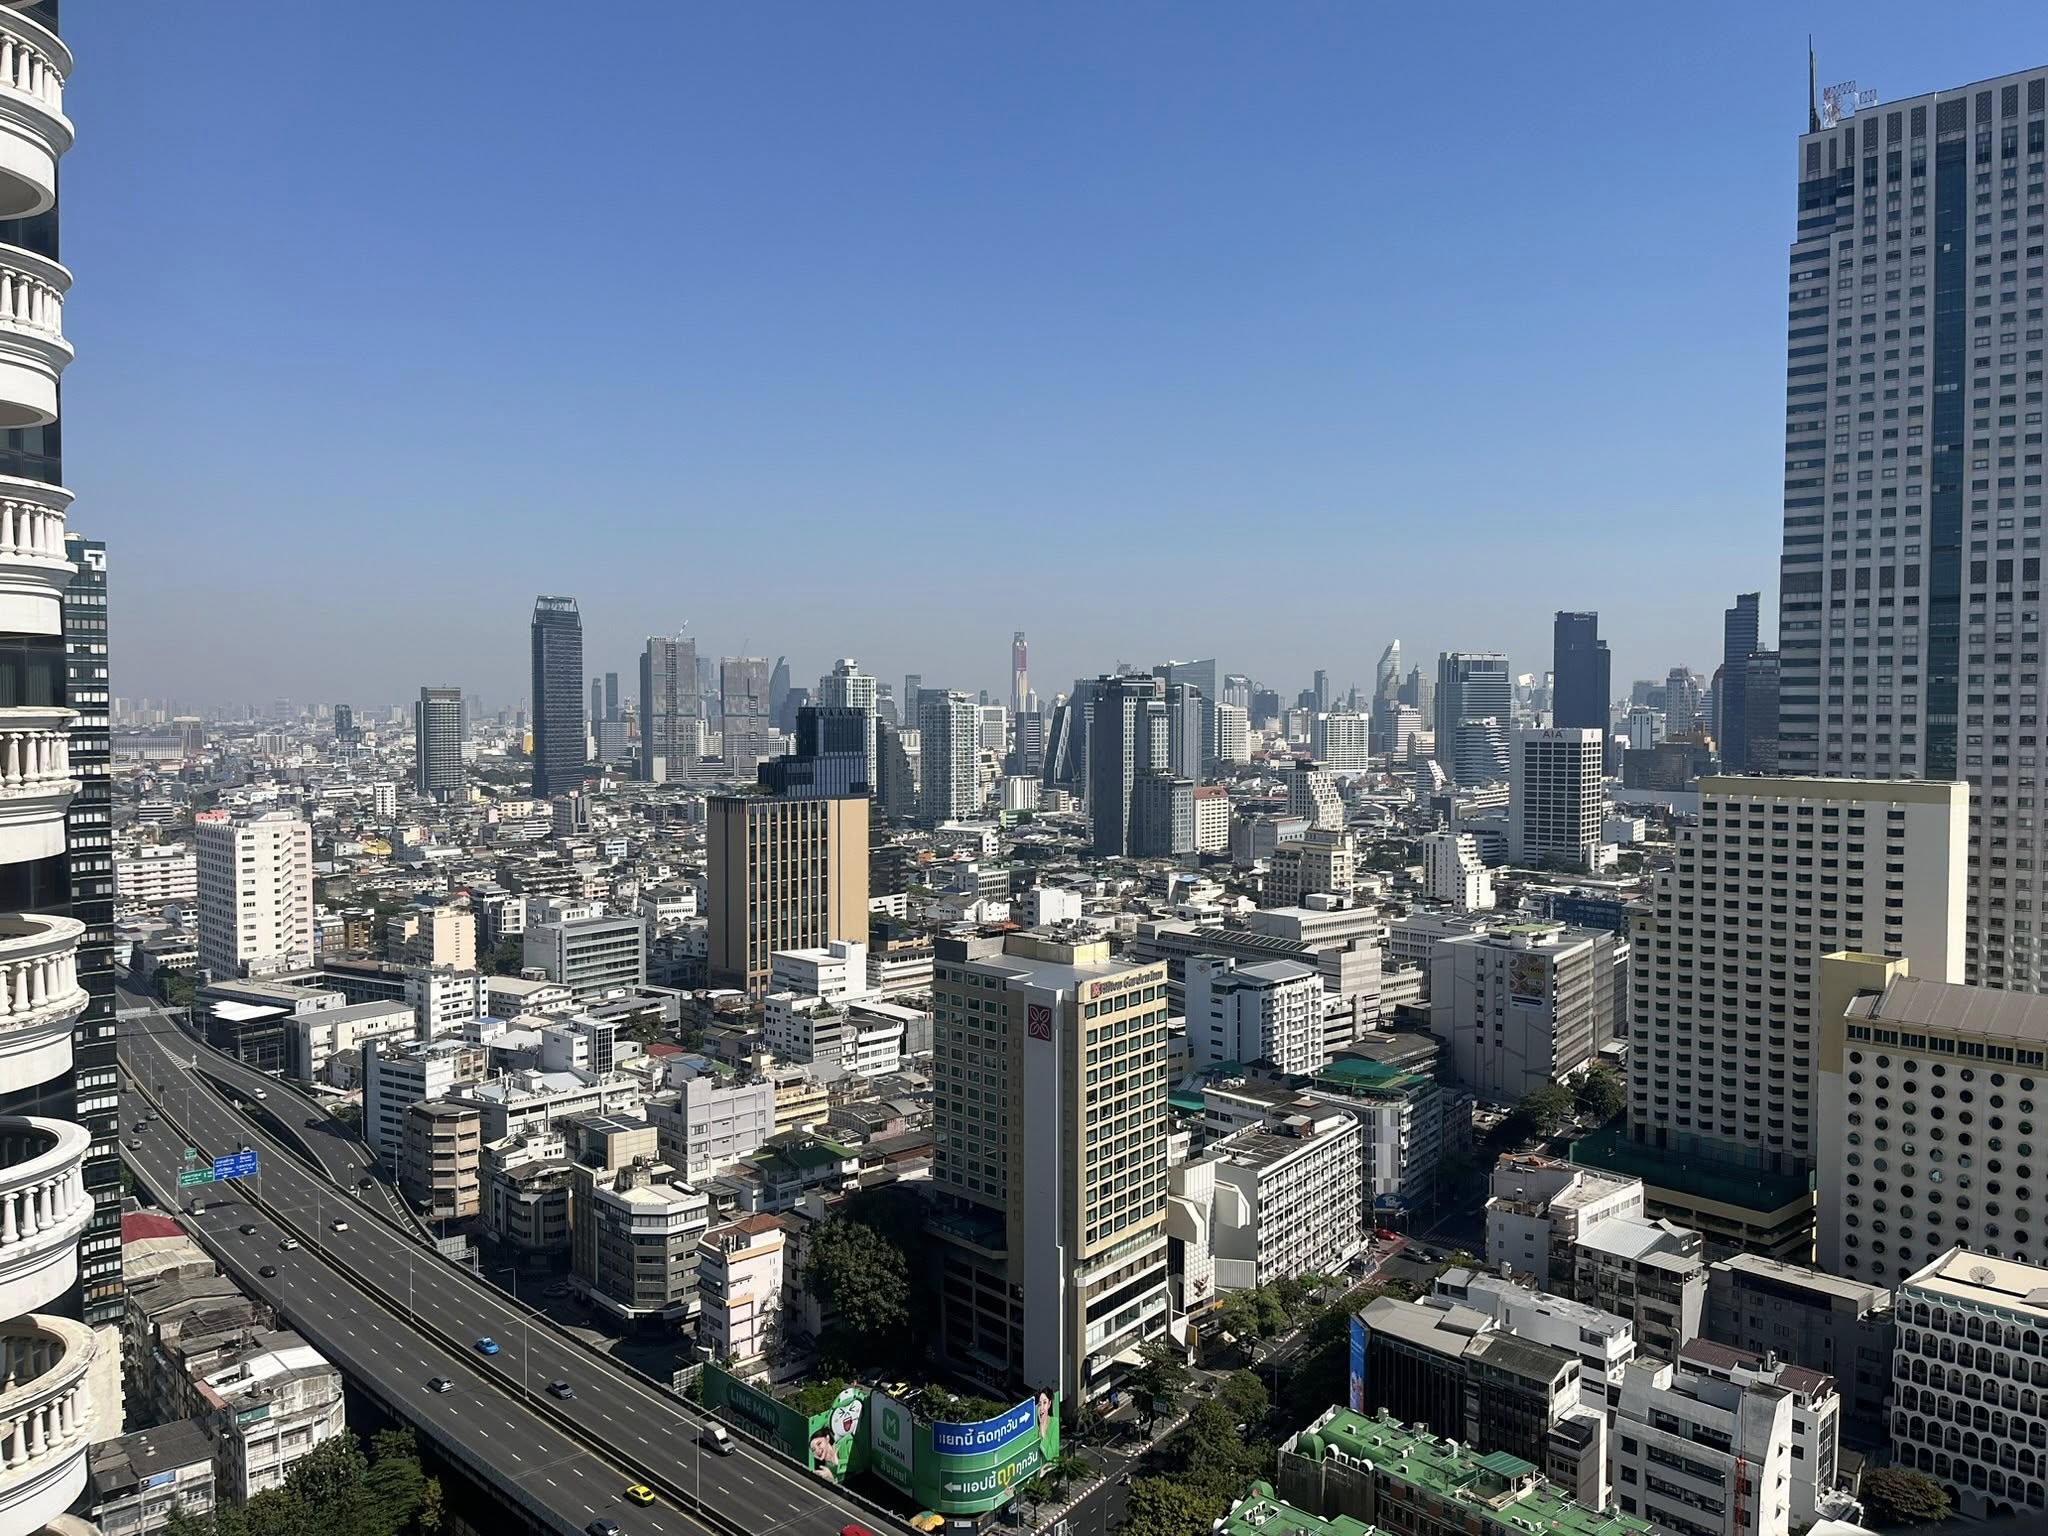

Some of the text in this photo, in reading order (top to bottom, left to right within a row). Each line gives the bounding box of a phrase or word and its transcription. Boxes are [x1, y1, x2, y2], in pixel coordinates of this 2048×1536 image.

[1542, 731, 1563, 739] AIA
[1124, 973, 1150, 988] Garden
[730, 1388, 776, 1425] LINE MAN
[939, 1418, 1018, 1446] แยกนี้ ติดทุกวัน
[877, 1437, 906, 1461] LINE MAN
